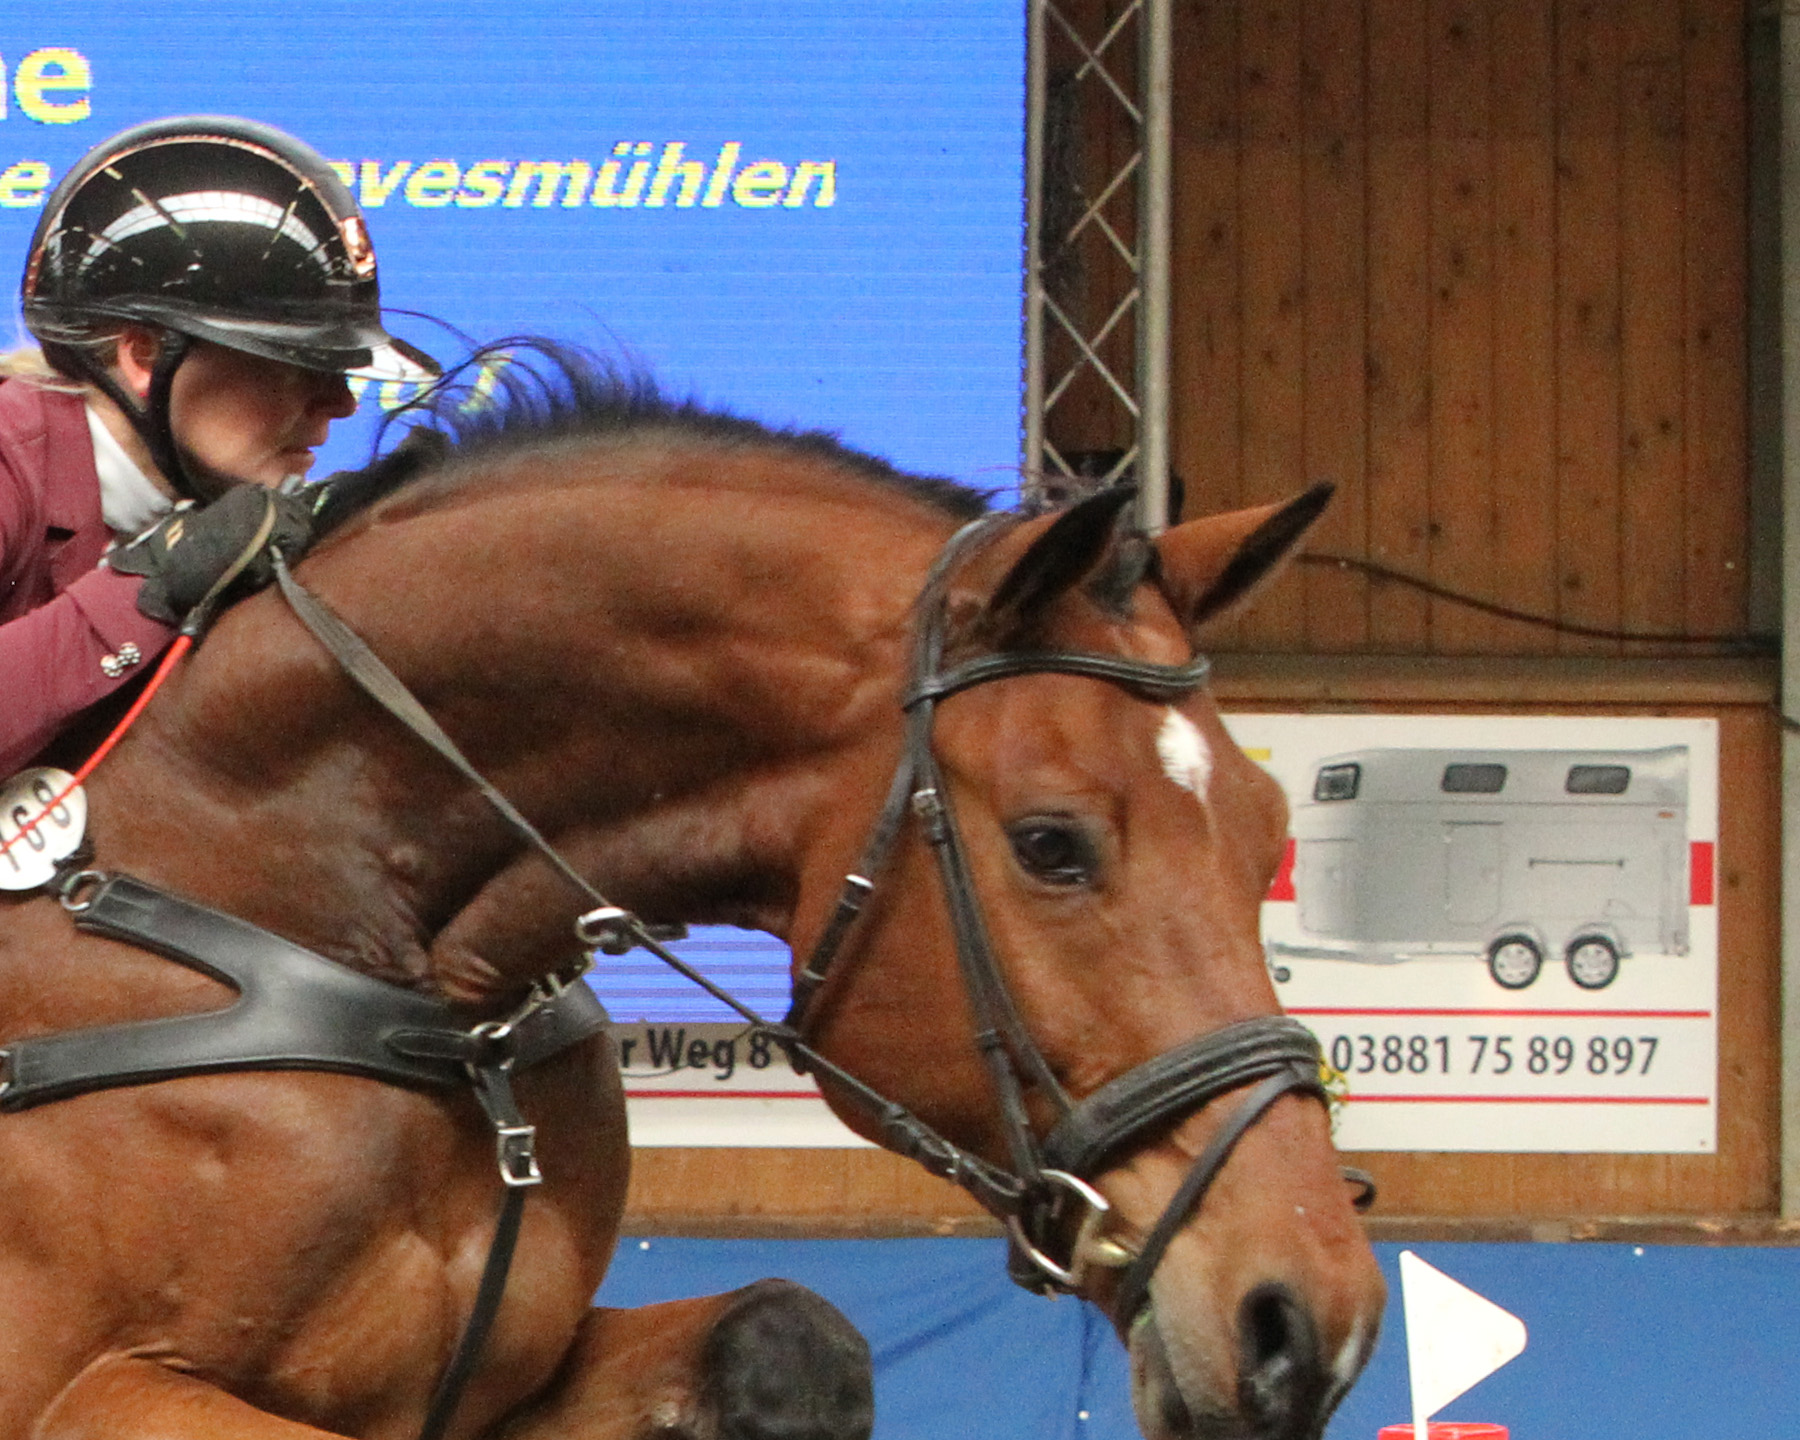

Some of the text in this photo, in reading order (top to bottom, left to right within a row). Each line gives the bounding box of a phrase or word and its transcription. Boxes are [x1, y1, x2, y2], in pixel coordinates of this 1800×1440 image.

[648, 1028, 736, 1080] Weg
[1331, 1035, 1659, 1076] 03881 75 89 897
